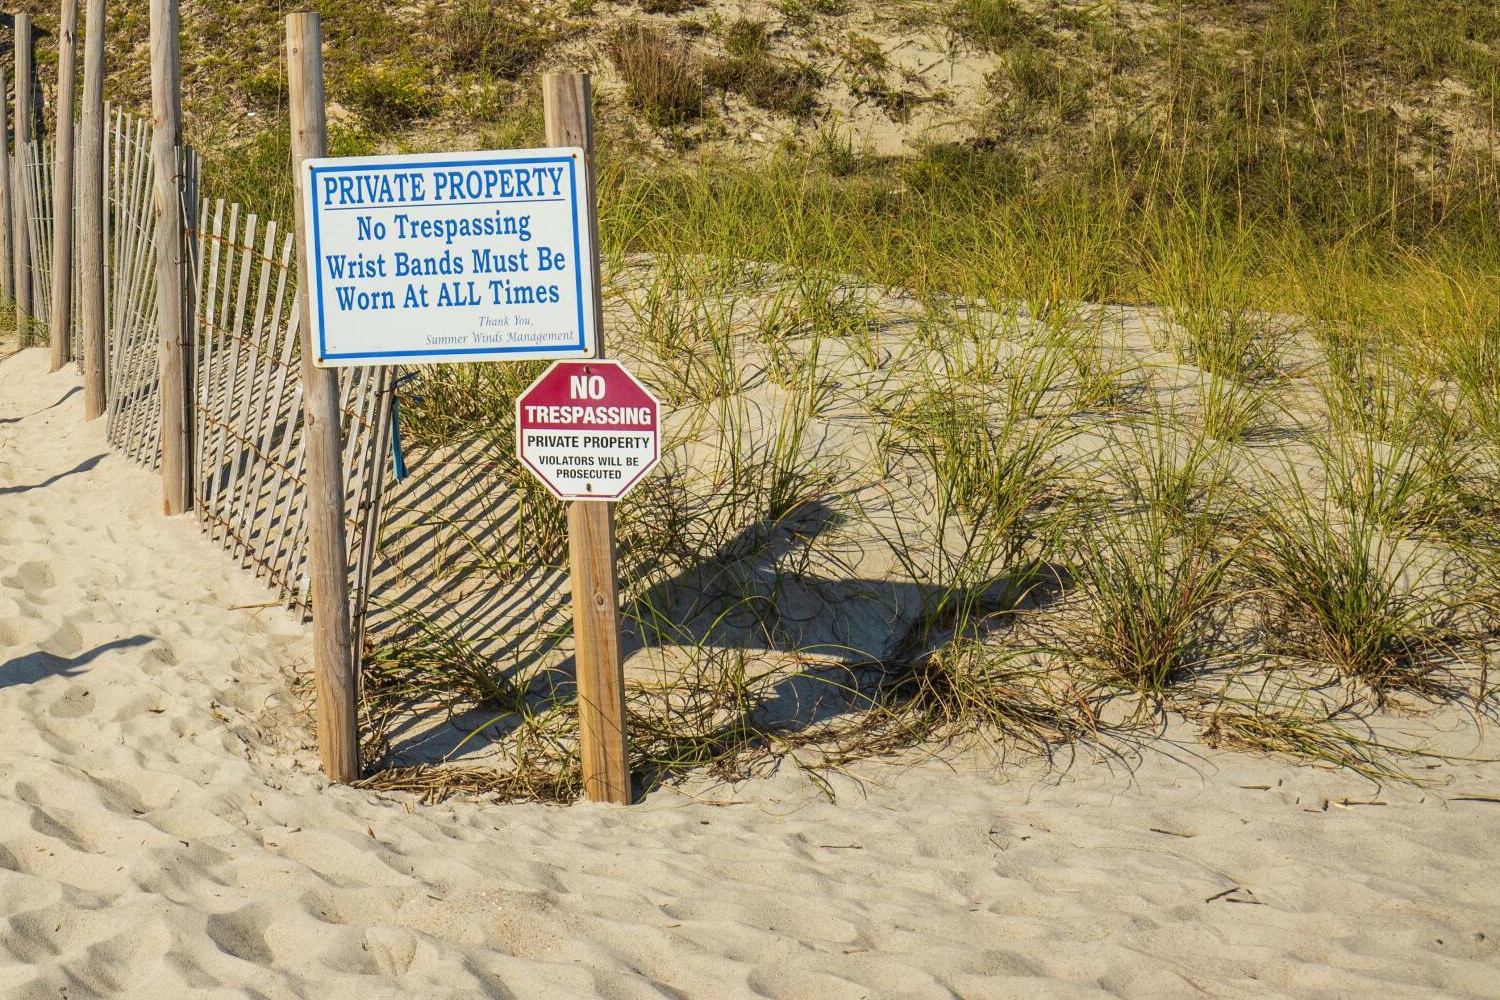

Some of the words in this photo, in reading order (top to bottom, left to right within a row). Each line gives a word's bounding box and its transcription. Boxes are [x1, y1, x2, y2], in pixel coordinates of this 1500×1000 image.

[323, 173, 426, 205] PRIVATE
[434, 167, 564, 200] PROPERTY
[357, 216, 386, 240] No
[394, 210, 532, 244] Trespassing
[326, 253, 387, 279] Wrist
[394, 250, 464, 277] Bands
[472, 248, 529, 274] Must
[537, 246, 566, 271] Be
[336, 285, 396, 311] Worn
[404, 283, 429, 308] At
[437, 281, 481, 307] ALL
[489, 279, 560, 305] Times
[478, 315, 510, 327] Thank
[425, 334, 468, 345] Summer
[471, 331, 503, 343] Winds
[505, 330, 574, 344] Management
[570, 375, 606, 400] NO
[525, 405, 652, 425] TRESPASSING
[527, 435, 579, 448] PRIVATE
[583, 436, 650, 449] PROPERTY
[539, 455, 595, 466] VIOLATORS
[598, 456, 622, 467] WILL
[626, 457, 639, 467] BE
[556, 469, 622, 480] PROSECUTED
